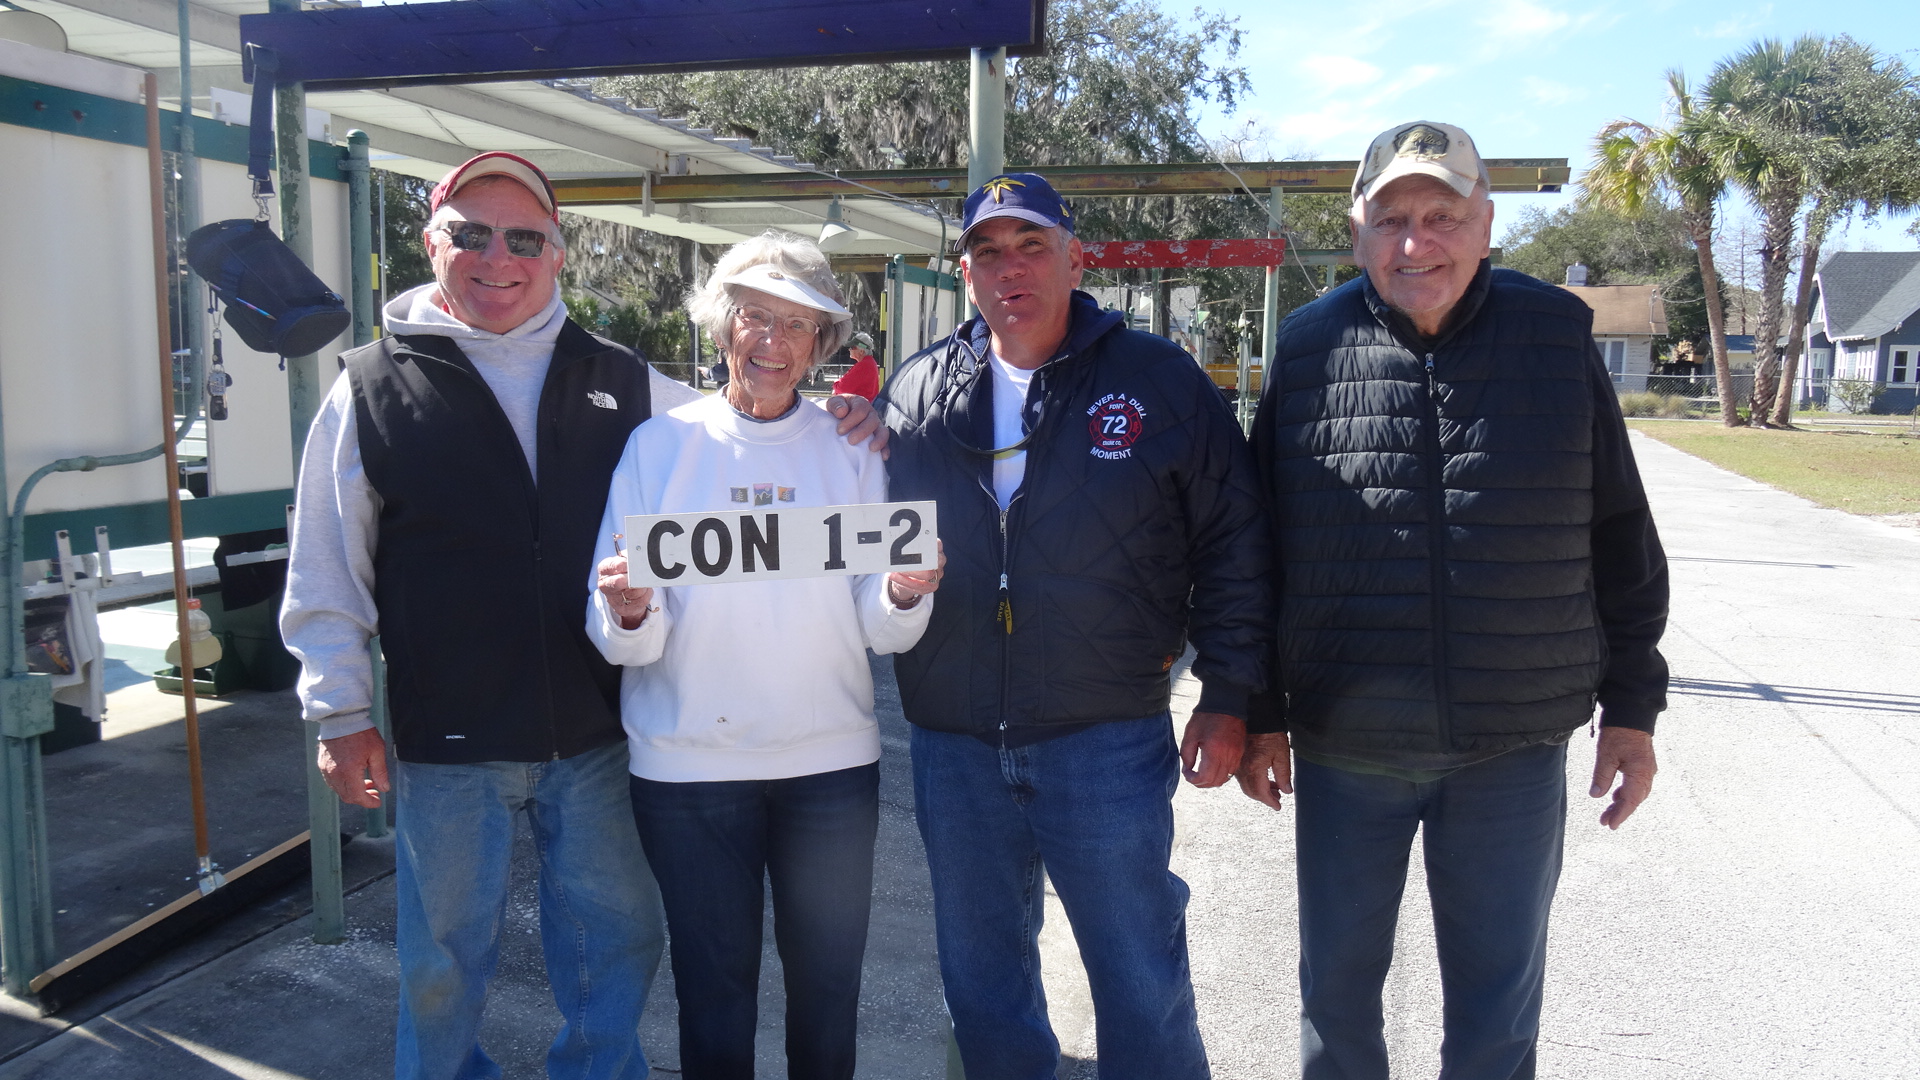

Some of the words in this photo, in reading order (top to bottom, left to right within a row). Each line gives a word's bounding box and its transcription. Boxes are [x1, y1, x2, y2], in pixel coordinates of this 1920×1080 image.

[1087, 394, 1114, 416] NEVER
[1128, 398, 1147, 419] DULL
[1103, 415, 1127, 434] 72
[1090, 447, 1131, 460] MOMENT
[646, 513, 780, 580] CON
[823, 508, 922, 571] 1-2
